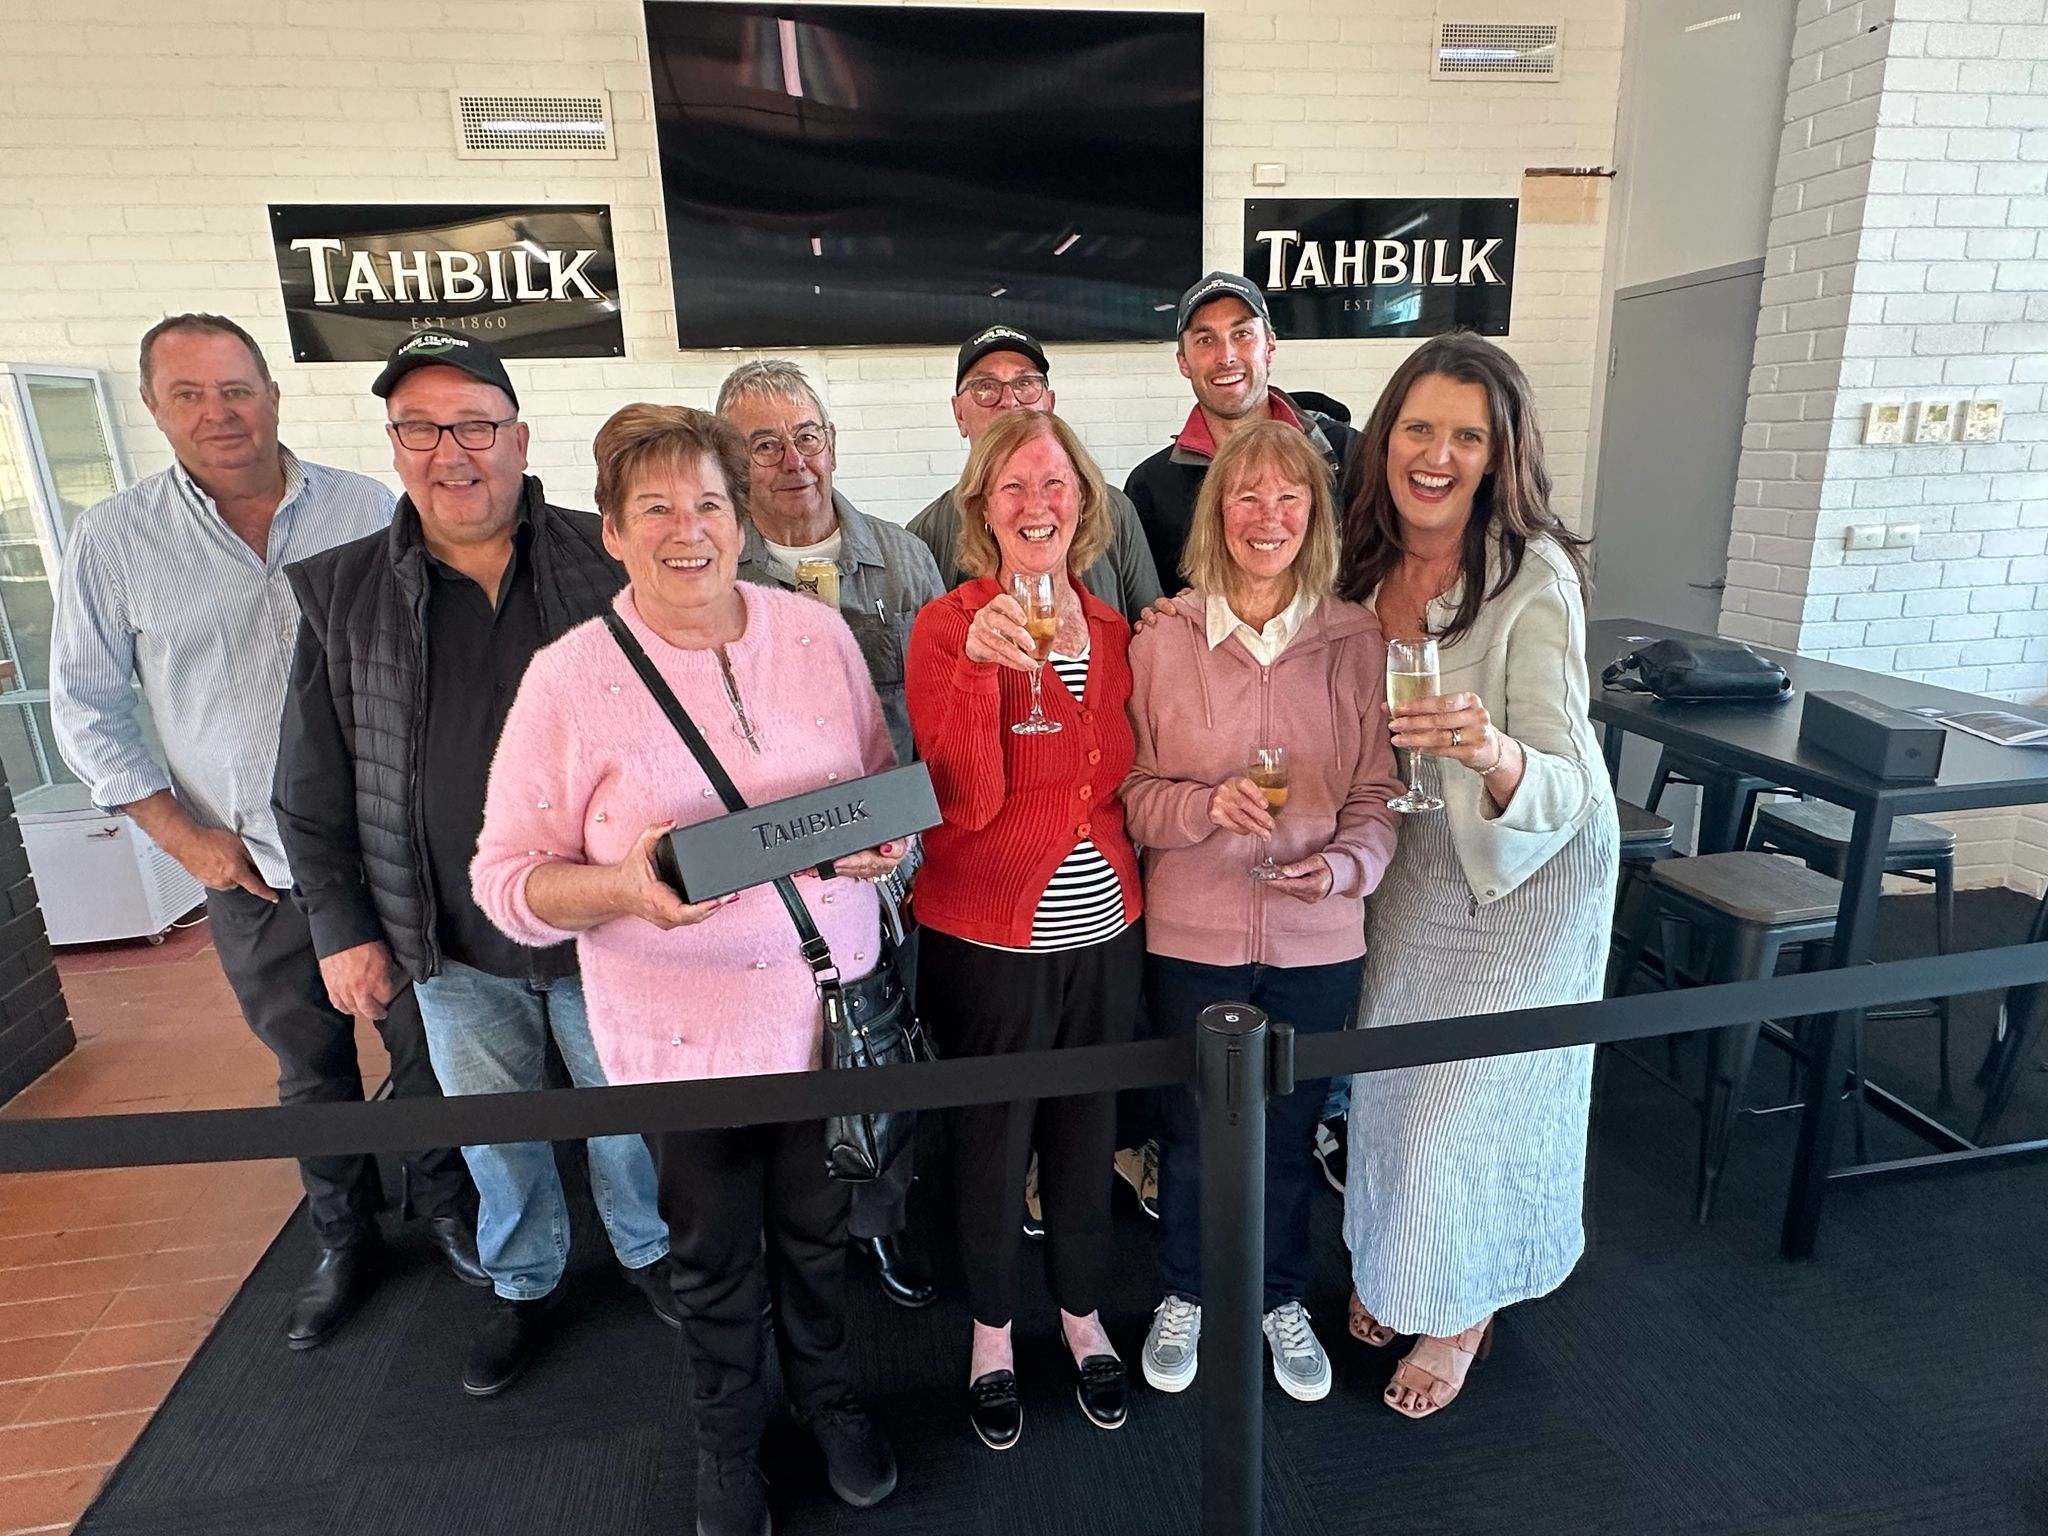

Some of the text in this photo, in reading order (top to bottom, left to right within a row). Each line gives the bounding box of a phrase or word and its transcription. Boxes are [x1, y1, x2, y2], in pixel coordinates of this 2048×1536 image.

[290, 238, 606, 305] TAHBILK
[1256, 230, 1505, 291] TAHBILK
[752, 799, 872, 850] TAHBILK
